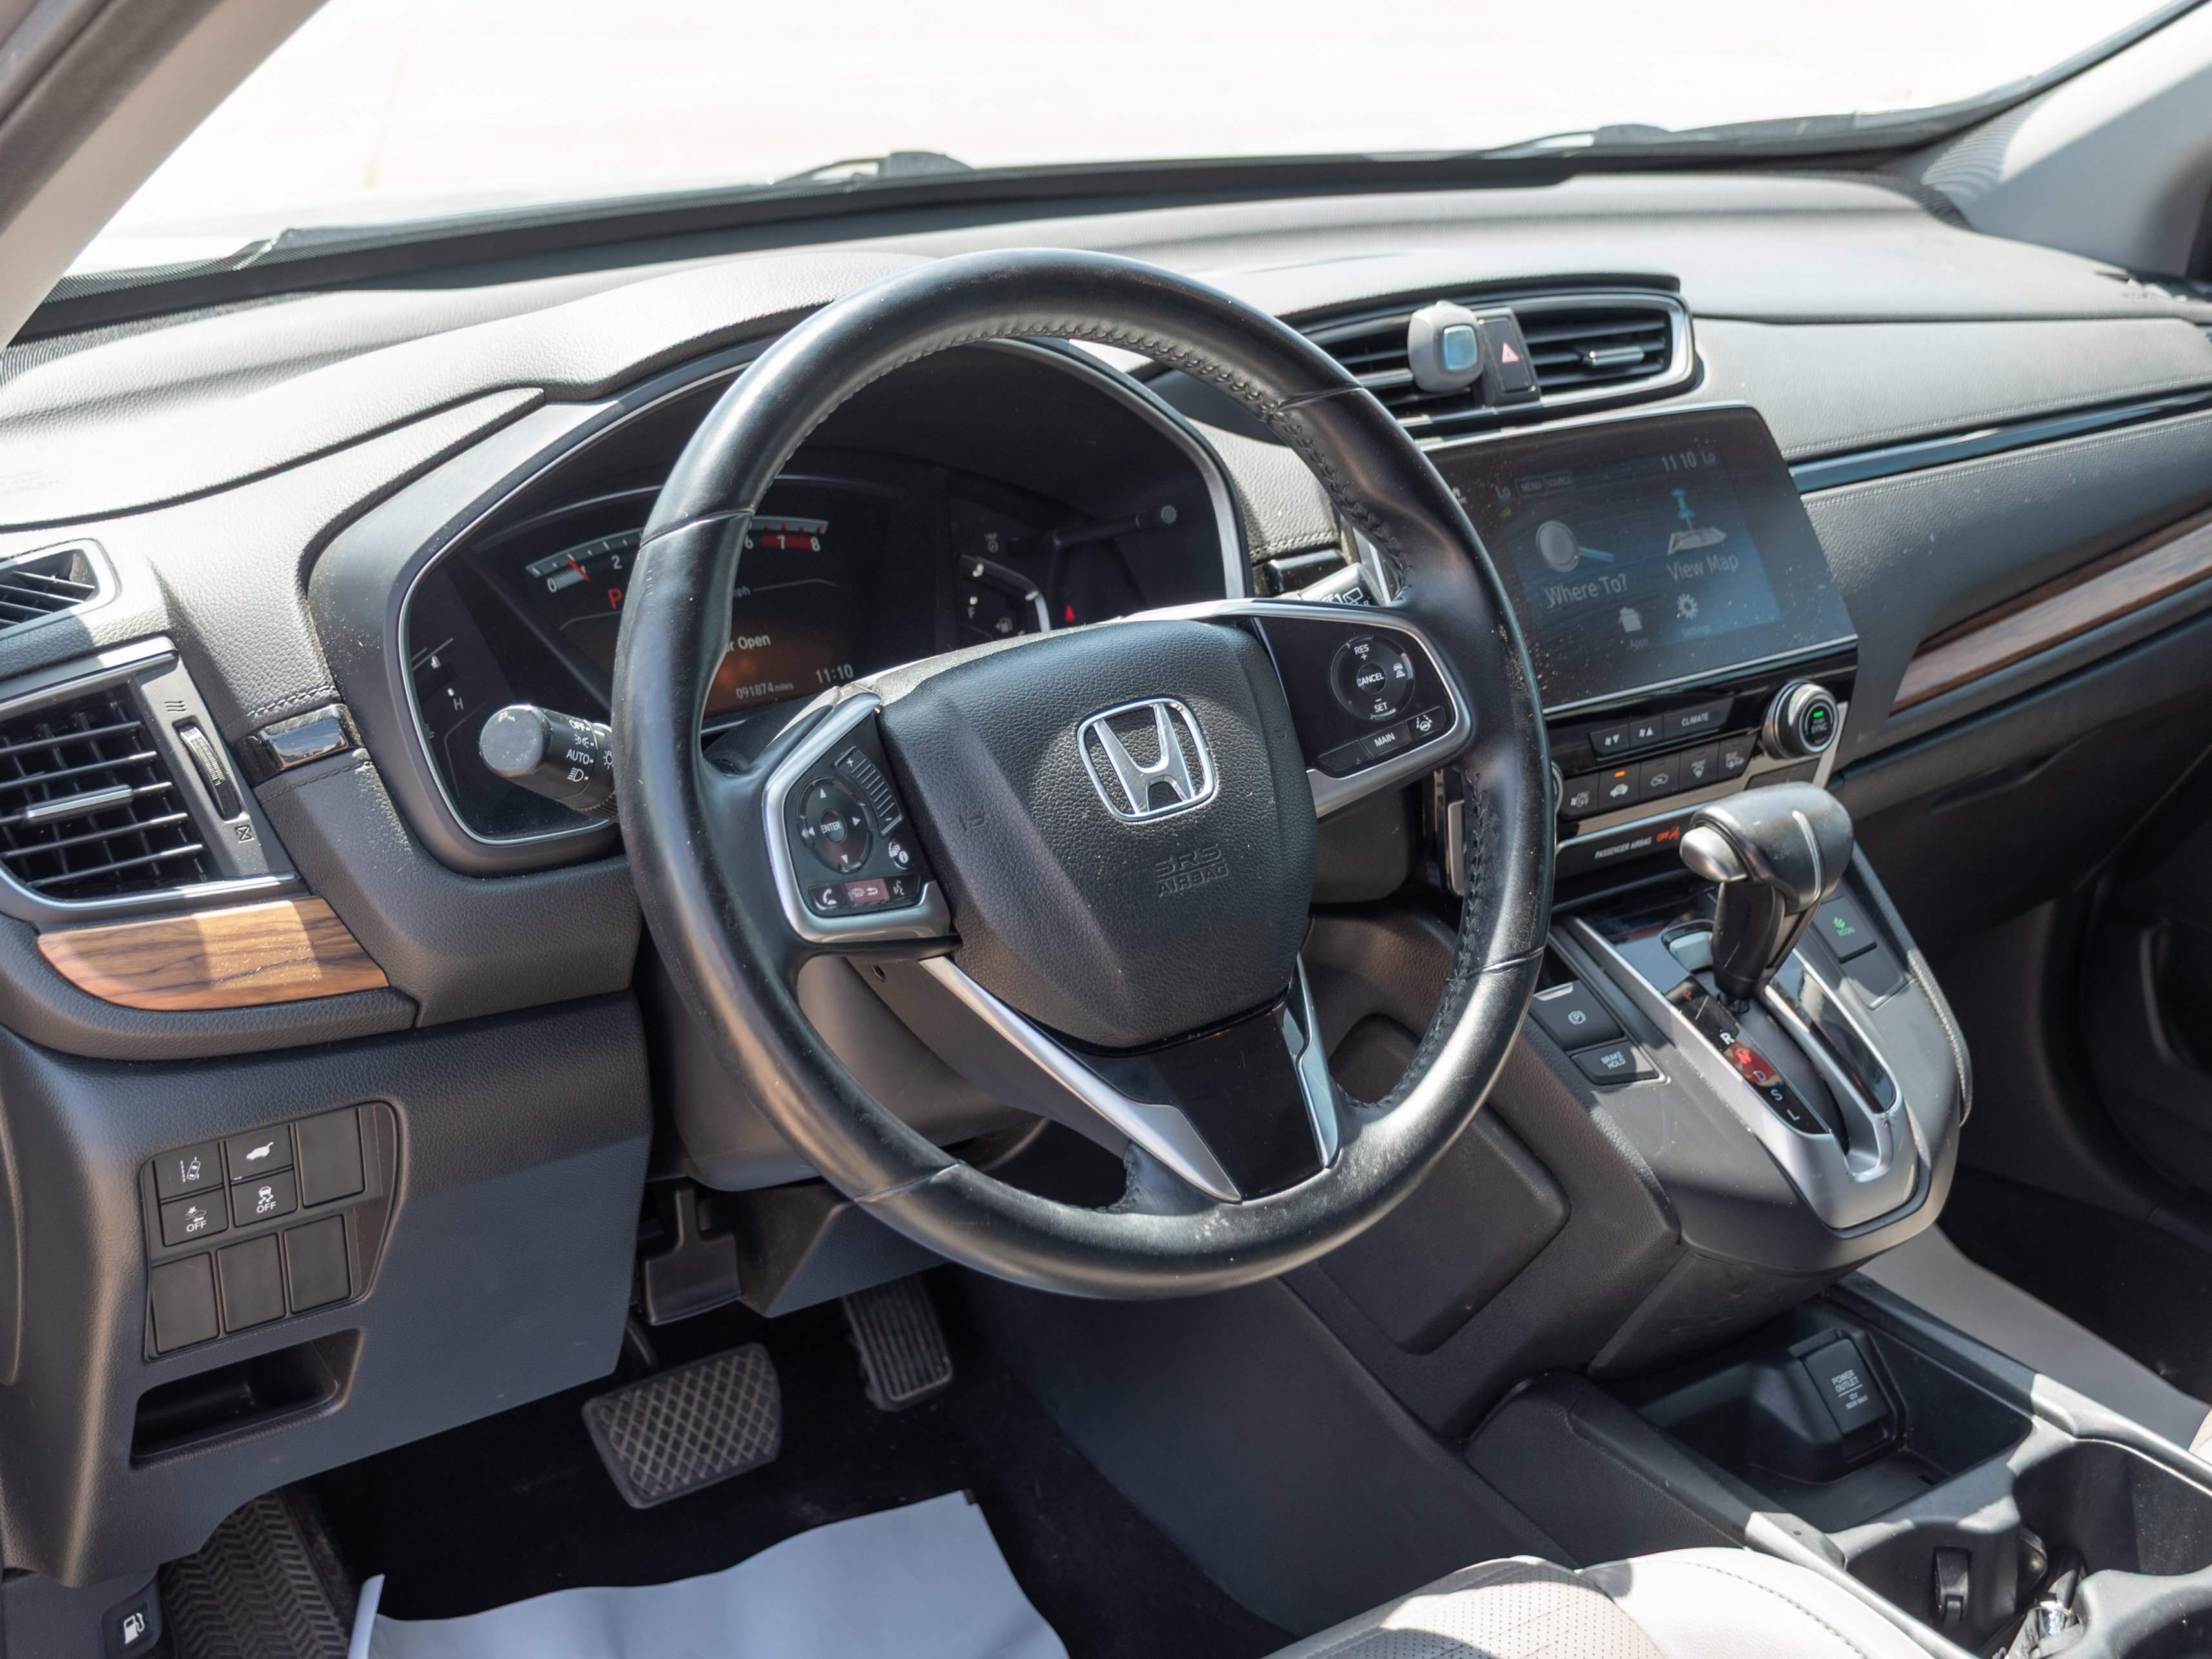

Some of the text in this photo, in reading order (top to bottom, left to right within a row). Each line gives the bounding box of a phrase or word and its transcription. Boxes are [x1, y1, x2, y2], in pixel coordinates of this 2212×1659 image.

[745, 535, 754, 549] 6
[777, 535, 786, 550] 7
[810, 536, 821, 552] 8
[611, 555, 623, 570] 2
[1666, 555, 1739, 581] View Map
[547, 577, 557, 592] 0
[1545, 573, 1628, 606] Where To?
[608, 588, 623, 609] P
[737, 635, 771, 650] Open
[1354, 644, 1369, 655] RES
[815, 664, 854, 684] 11:10
[1357, 672, 1384, 687] CANCEL
[735, 682, 774, 699] 091874
[453, 697, 464, 711] H
[1374, 702, 1388, 713] SET
[569, 719, 586, 731] OFF
[1681, 712, 1709, 727] CLIMATE
[1374, 733, 1395, 747] MAIN
[566, 748, 590, 765] AUTO
[821, 821, 841, 833] ENTER
[1595, 842, 1630, 859] PASSENGER
[1629, 836, 1651, 849] AIRBAG
[1155, 843, 1222, 879] SRS
[1158, 864, 1228, 897] AIRBAG
[1720, 1032, 1735, 1045] R
[1600, 1050, 1624, 1064] BRAKE
[1606, 1057, 1626, 1070] HOLD
[1753, 1070, 1766, 1082] D
[1771, 1089, 1783, 1101] S
[1787, 1109, 1800, 1121] L
[256, 1201, 276, 1213] OFF
[186, 1220, 206, 1232] OFF
[1831, 1369, 1855, 1386] POWER
[1835, 1375, 1859, 1393] OUTLET
